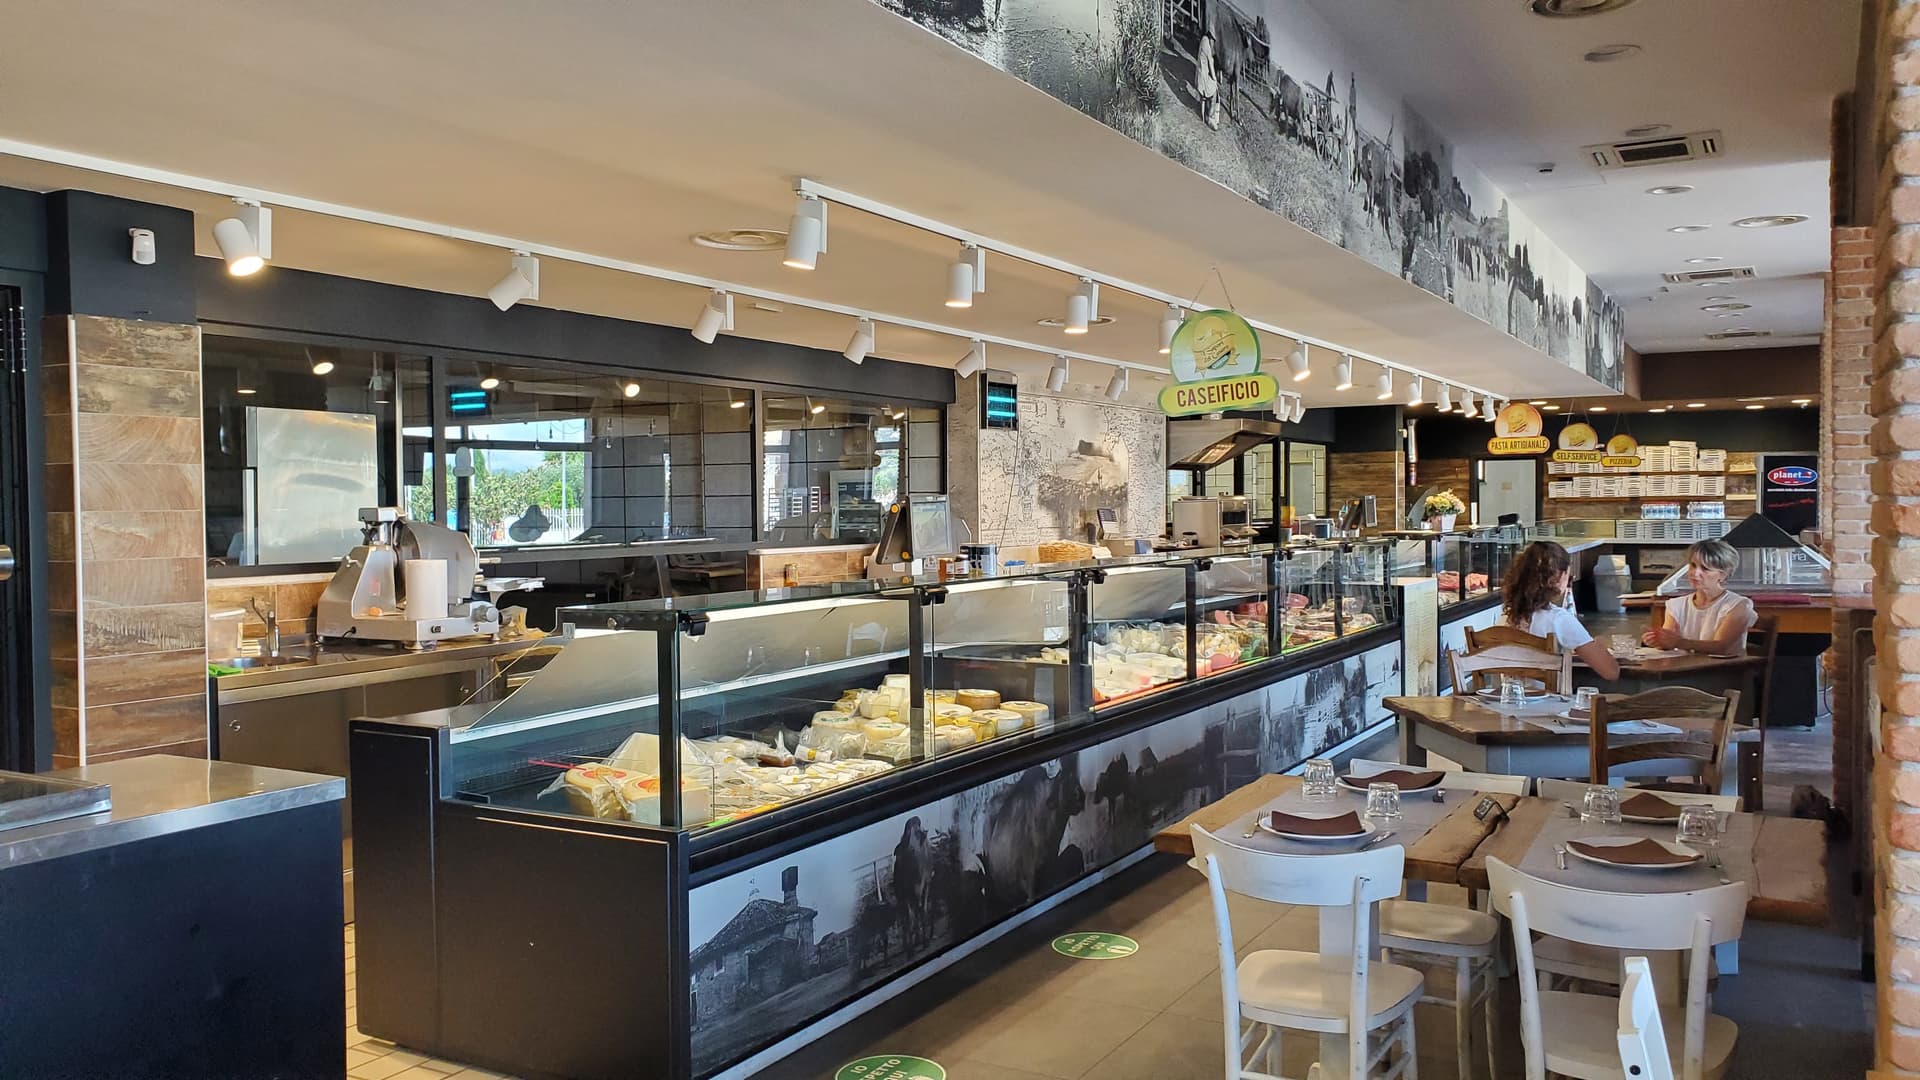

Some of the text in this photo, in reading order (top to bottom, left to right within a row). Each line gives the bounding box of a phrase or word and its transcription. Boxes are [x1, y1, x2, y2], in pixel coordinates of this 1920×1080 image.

[1177, 380, 1260, 408] CASEIFICIO
[1491, 439, 1547, 450] PASTA ARTIGIANALE
[850, 1065, 868, 1074] IO
